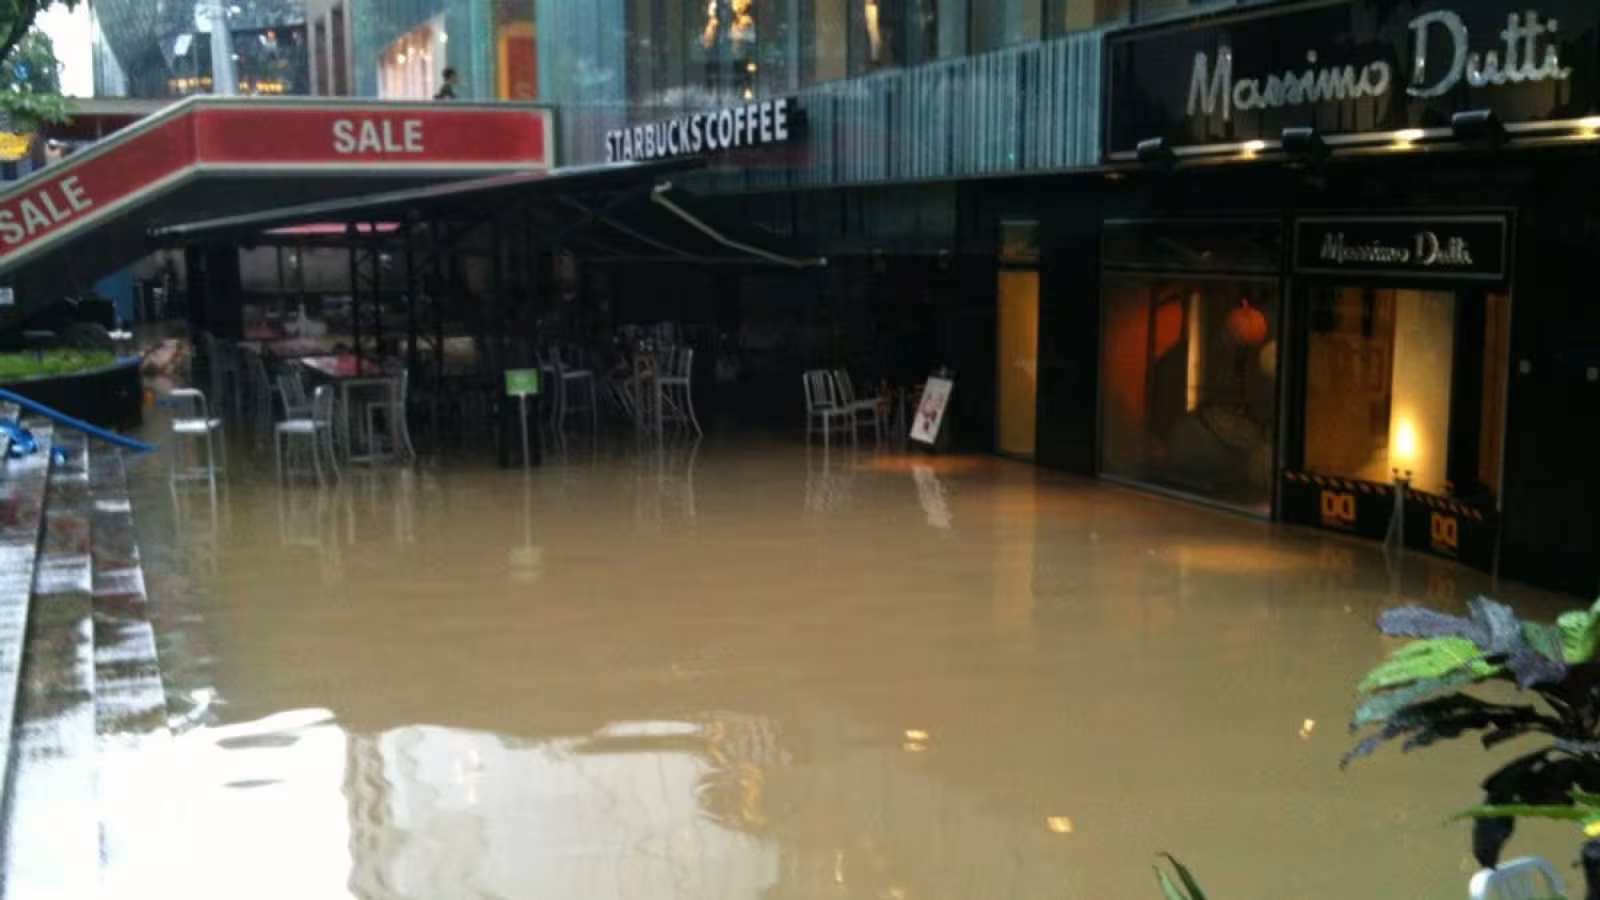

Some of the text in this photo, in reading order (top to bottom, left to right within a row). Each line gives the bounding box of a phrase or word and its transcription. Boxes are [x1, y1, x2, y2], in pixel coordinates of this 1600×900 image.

[1186, 10, 1571, 121] Massimo Dutti
[333, 119, 424, 153] SALE
[606, 99, 788, 163] STARBUCKS COFFEE
[0, 176, 92, 243] SALE
